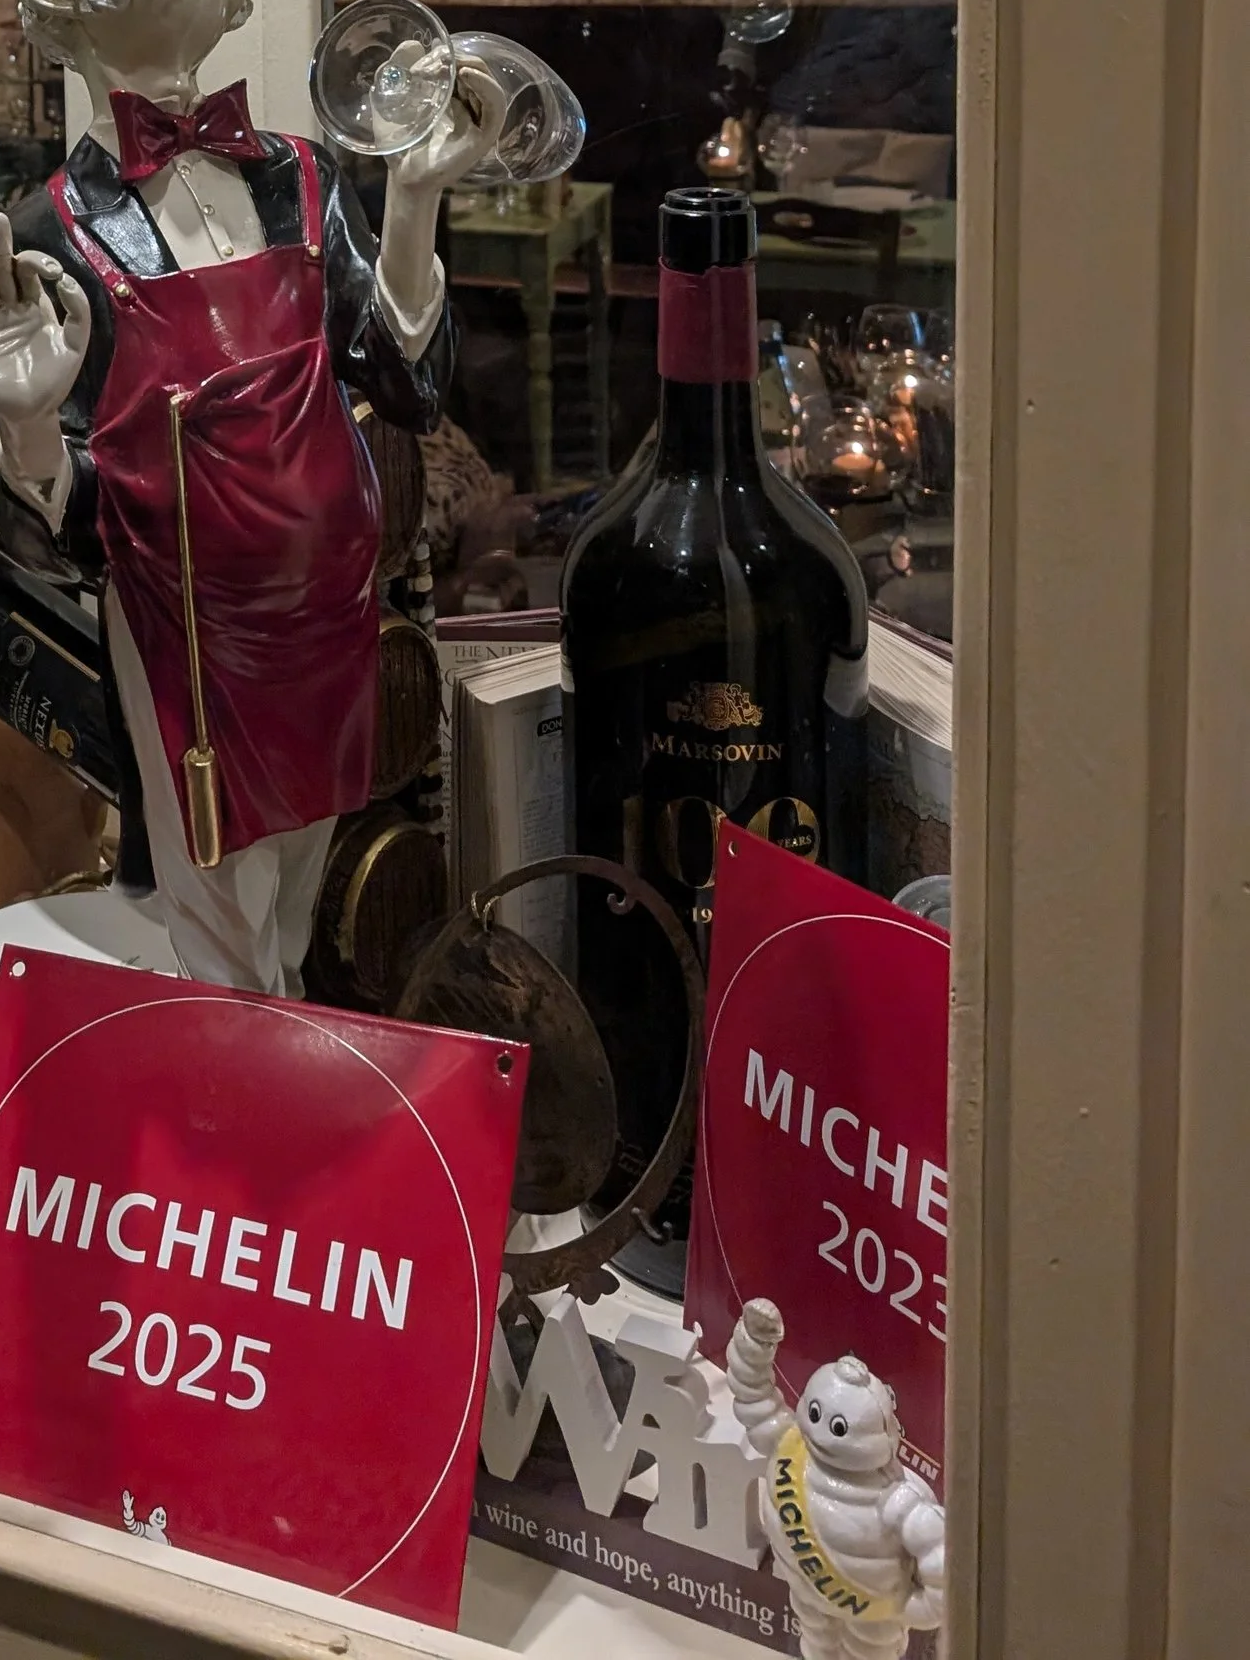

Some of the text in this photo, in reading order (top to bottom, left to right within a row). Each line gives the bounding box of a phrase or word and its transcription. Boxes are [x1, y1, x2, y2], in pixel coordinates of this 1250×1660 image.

[452, 644, 482, 658] THE
[651, 732, 784, 761] MARSOVIN
[744, 1048, 948, 1238] MICHE
[5, 1166, 413, 1330] MICHELIN
[87, 1300, 272, 1411] 2025
[486, 1503, 538, 1539] wine
[545, 1526, 587, 1558] and
[595, 1536, 661, 1589] hope,
[667, 1571, 774, 1637] anything
[775, 1457, 871, 1616] MICHELIN
